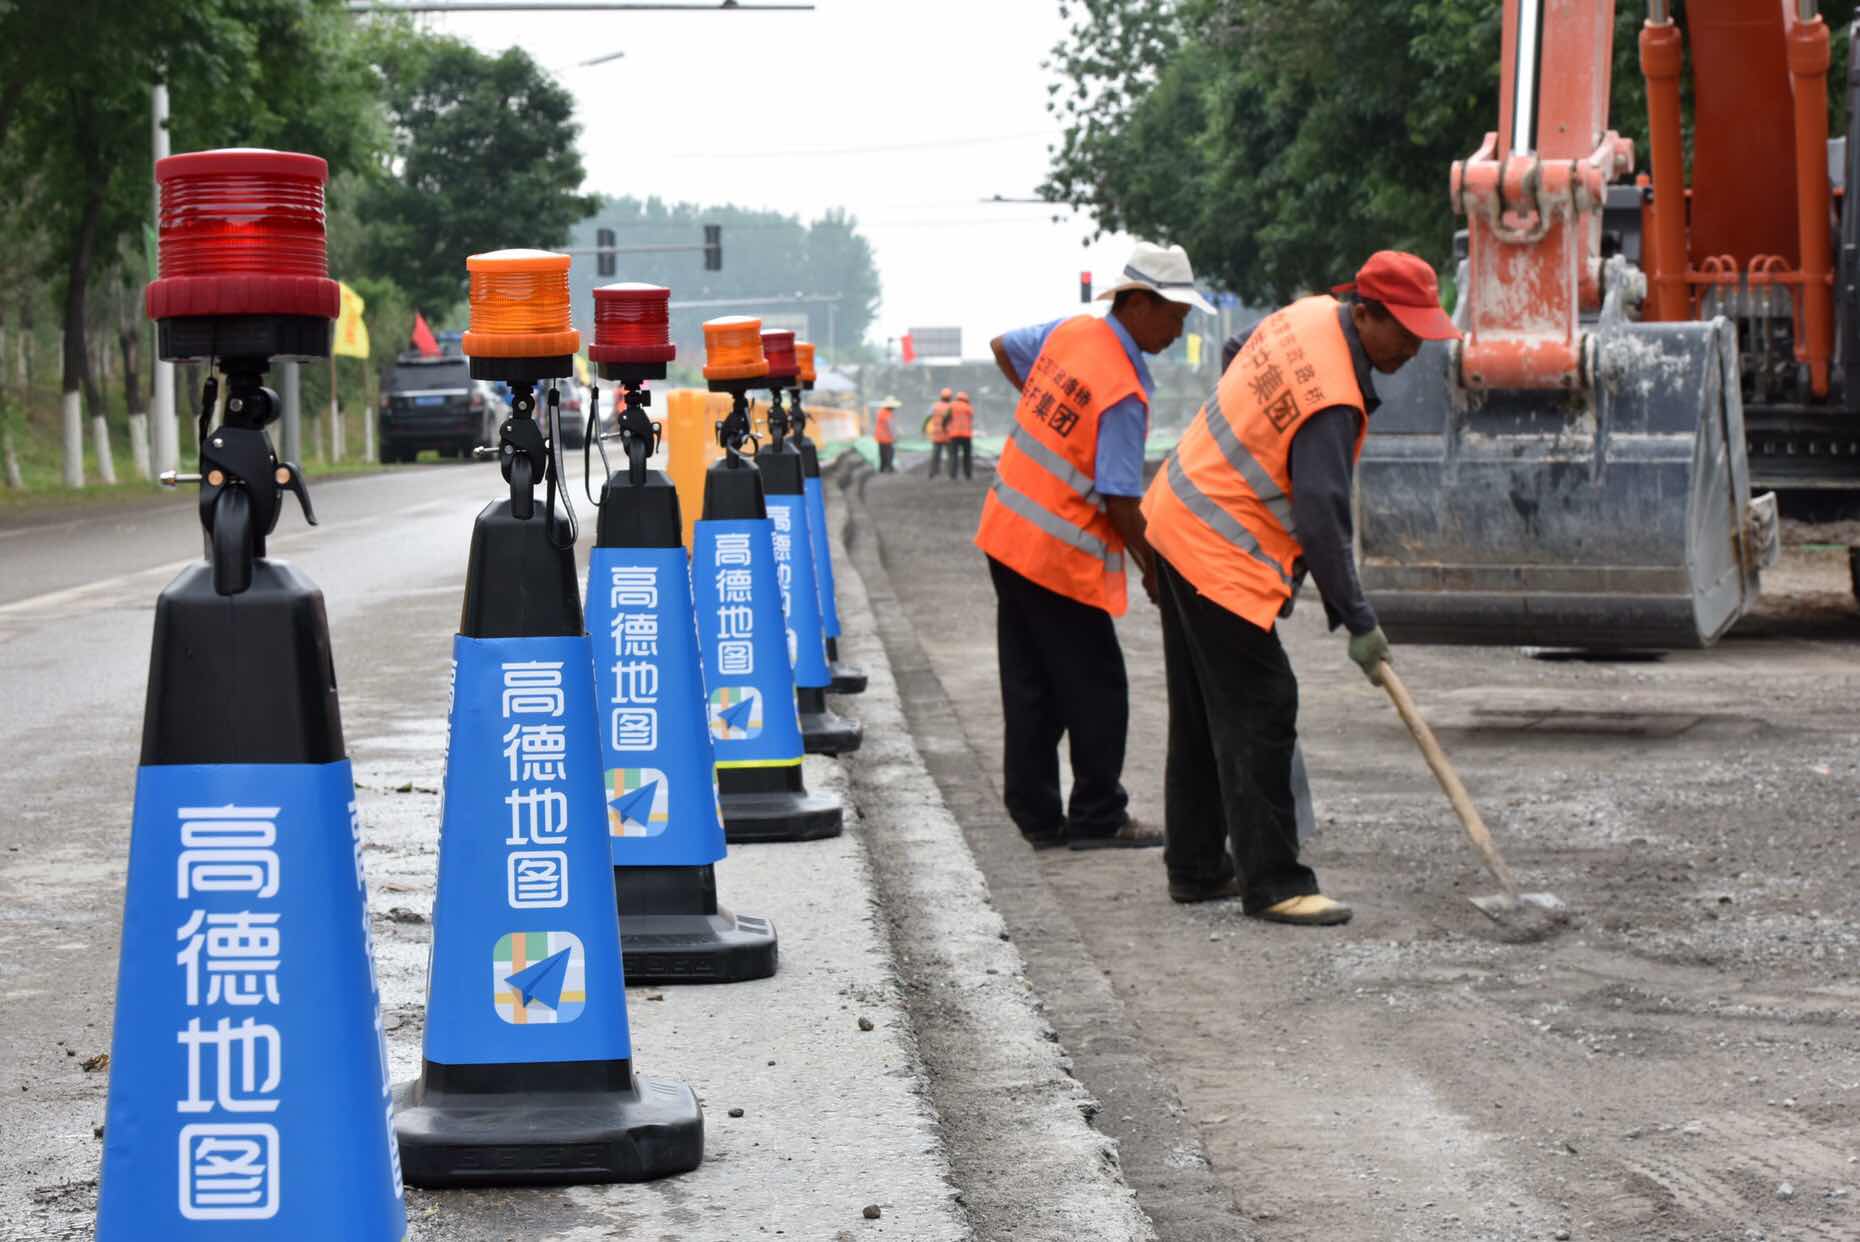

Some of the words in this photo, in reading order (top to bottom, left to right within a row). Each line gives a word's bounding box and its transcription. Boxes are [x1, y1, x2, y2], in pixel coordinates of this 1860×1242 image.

[715, 533, 754, 675] 高德地图
[766, 505, 792, 617] 高德地
[610, 565, 659, 752] 高德地图
[501, 660, 569, 909] 高德地图
[176, 803, 281, 1220] 高德地图
